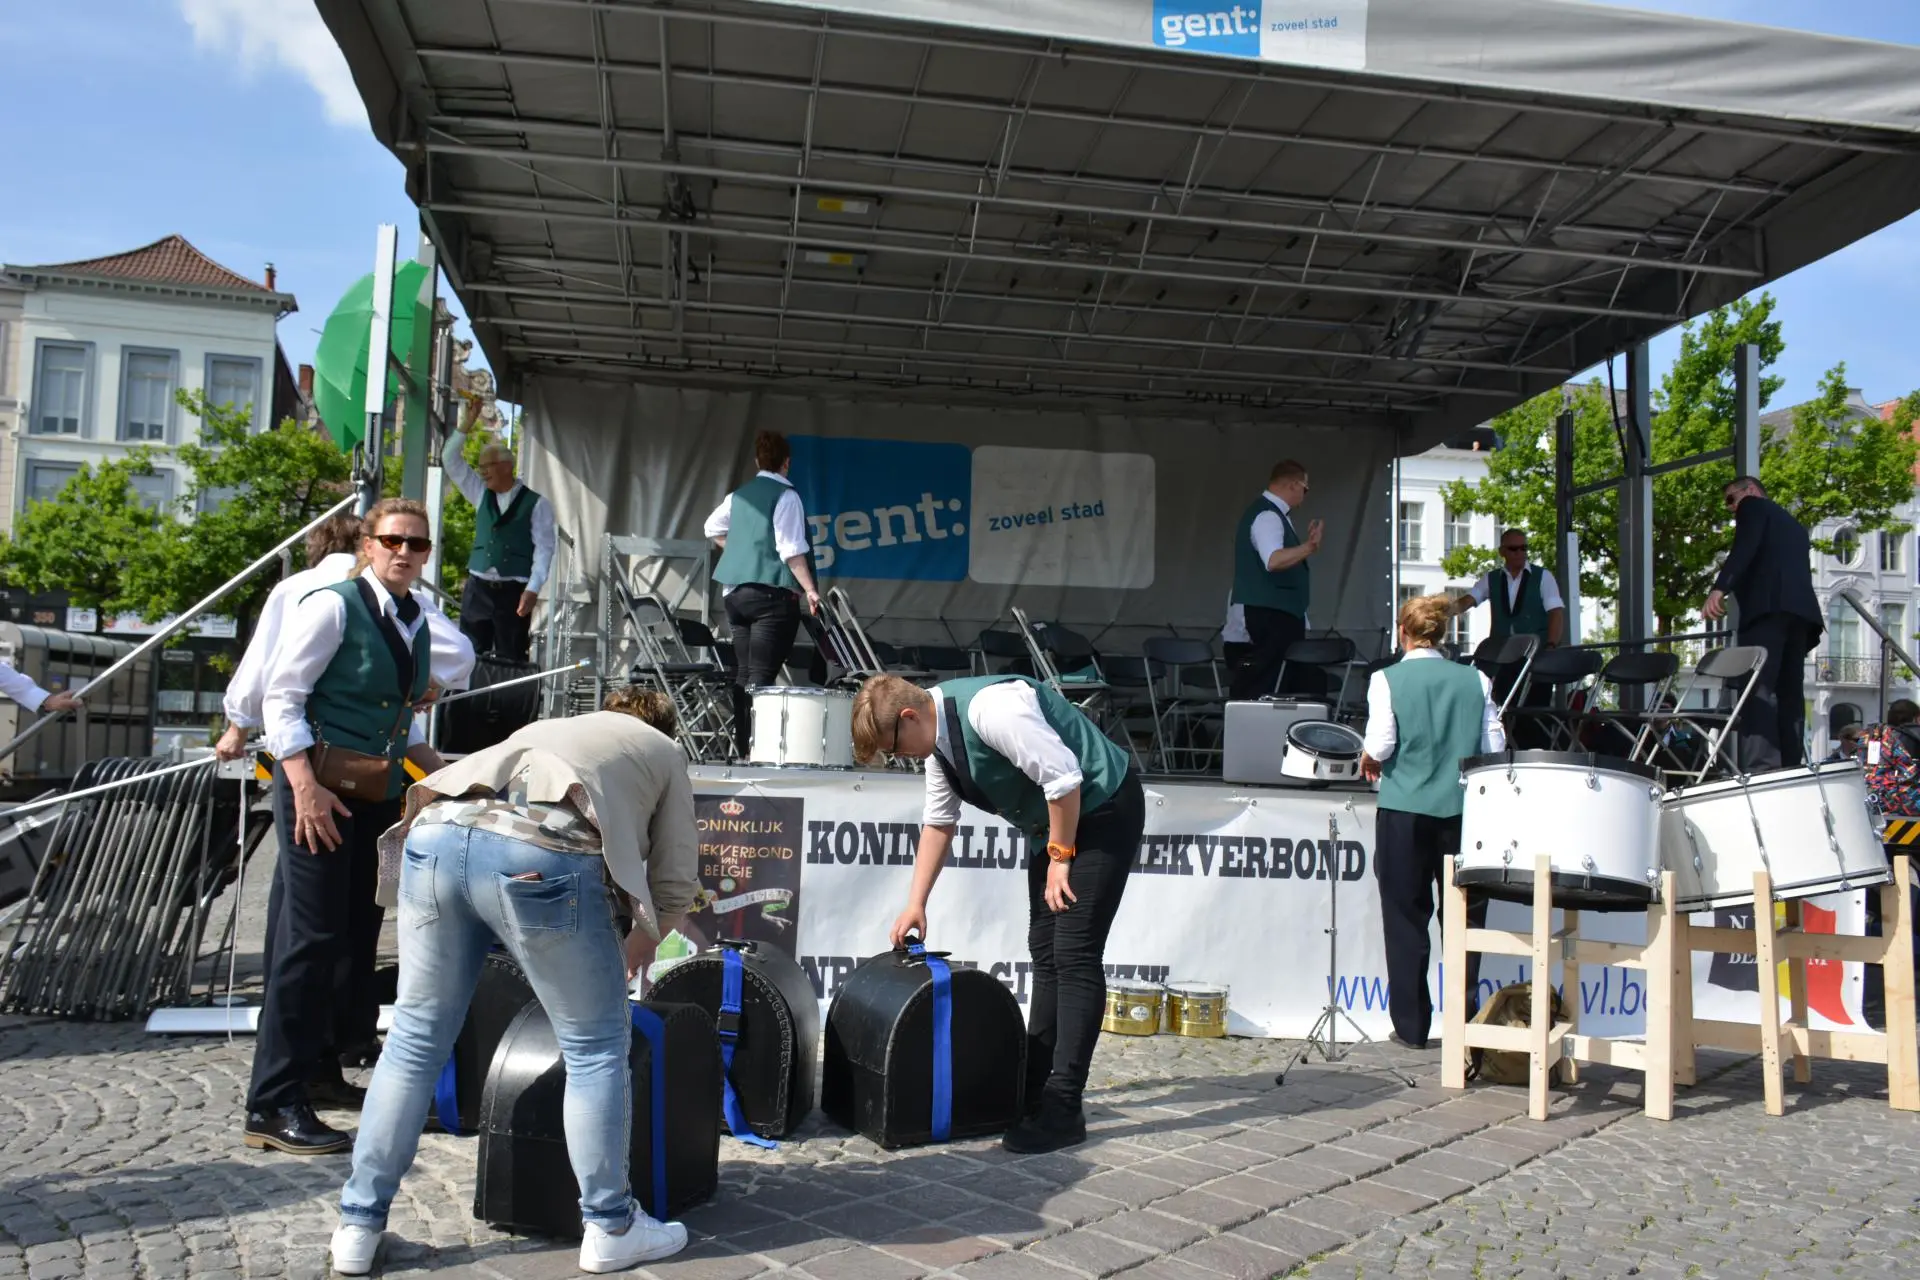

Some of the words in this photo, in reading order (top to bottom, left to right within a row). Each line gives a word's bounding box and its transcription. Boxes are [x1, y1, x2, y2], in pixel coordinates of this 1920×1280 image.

[1161, 5, 1259, 46] gent:
[1271, 17, 1308, 32] zoveel
[1312, 15, 1338, 30] stad
[989, 505, 1053, 532] zoveel
[1061, 500, 1105, 521] stad
[806, 492, 966, 570] gent:
[696, 819, 783, 834] ONINKLIJK
[699, 843, 794, 860] IEKVERBOND
[806, 820, 1029, 869] KONINLIJ
[1129, 834, 1366, 881] IEKVERBOND
[721, 857, 738, 865] VAN
[704, 864, 753, 878] BELGIE
